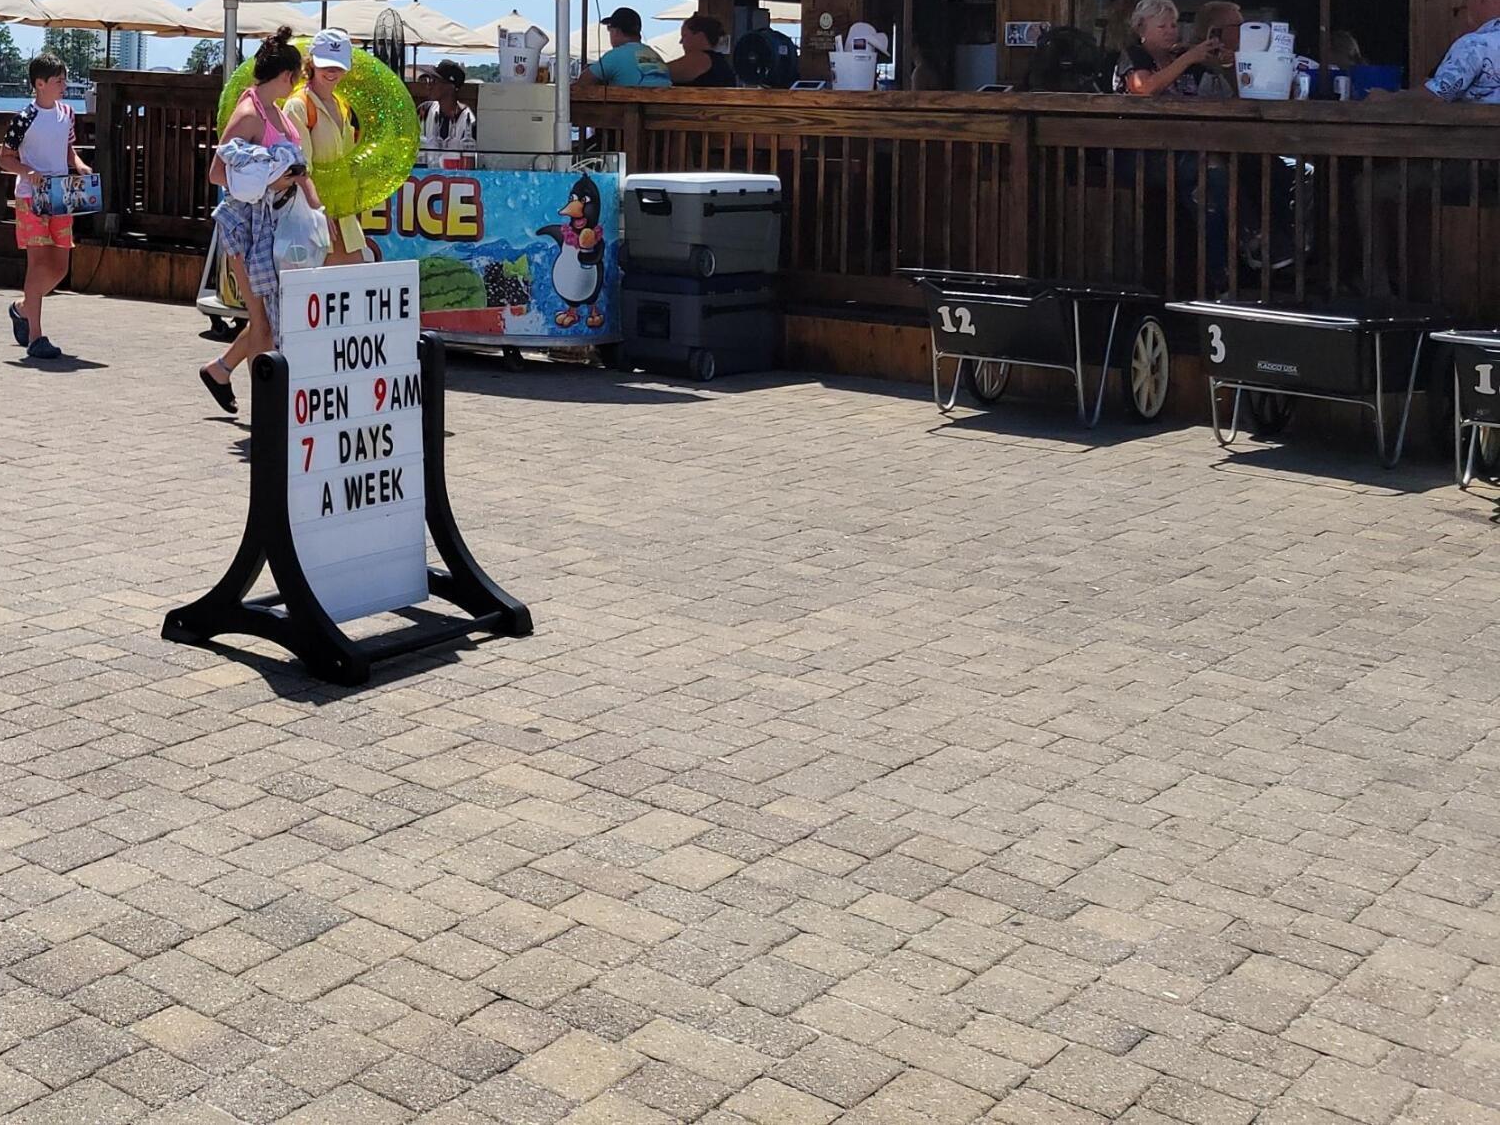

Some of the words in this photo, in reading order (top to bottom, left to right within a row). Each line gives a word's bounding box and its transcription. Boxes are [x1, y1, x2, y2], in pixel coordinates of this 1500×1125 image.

[400, 178, 480, 238] ICE
[307, 291, 350, 328] OFF
[365, 287, 409, 321] THE
[936, 306, 976, 336] 12
[333, 333, 387, 372] HOOK
[1207, 324, 1226, 363] 3
[1474, 363, 1500, 394] 1
[295, 385, 348, 425] OPEN
[302, 437, 314, 473] 7
[339, 423, 393, 464] DAYS
[322, 482, 333, 516] A
[345, 468, 403, 511] WEEK
